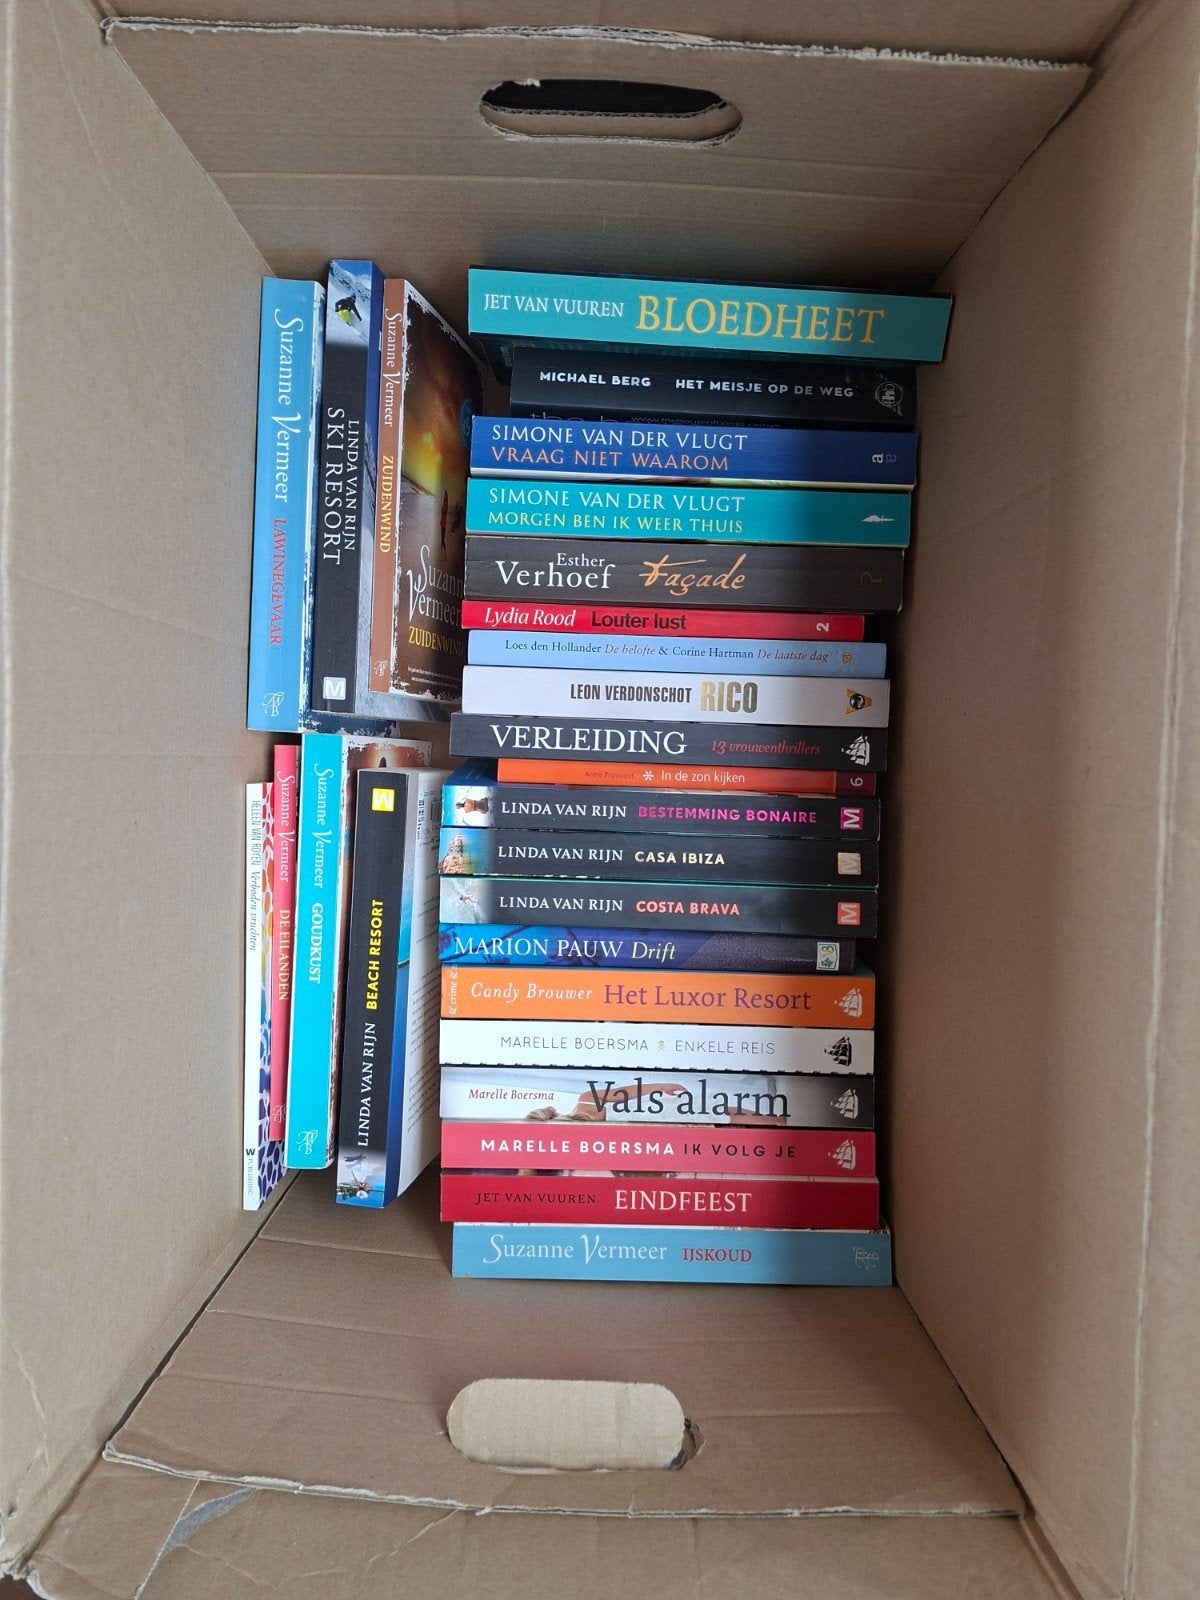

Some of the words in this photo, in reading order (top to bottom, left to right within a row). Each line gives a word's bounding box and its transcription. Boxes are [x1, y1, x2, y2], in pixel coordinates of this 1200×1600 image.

[483, 293, 511, 311] JET
[514, 296, 549, 312] VAN
[553, 298, 625, 318] VUUREN
[635, 295, 885, 344] BLOEDHEET
[385, 308, 402, 367] Suzanne
[274, 308, 304, 406] Suzanne
[539, 371, 606, 385] MICHAEL
[612, 375, 651, 387] BERG
[675, 378, 704, 390] HET
[709, 381, 763, 393] MEISJE
[767, 383, 788, 394] OP
[794, 385, 813, 395] DE
[820, 386, 853, 397] WEG
[382, 371, 401, 427] Vermeer
[326, 407, 345, 450] SKI
[492, 425, 573, 444] SIMONE
[582, 428, 624, 445] VAN
[630, 431, 669, 448] DER
[676, 433, 748, 450] VLUGT
[271, 412, 302, 503] Vermeer
[346, 420, 360, 476] LINDA
[491, 446, 565, 464] VRAAG
[574, 450, 622, 466] NIET
[631, 453, 729, 471] WAAROM
[345, 478, 358, 510] VAN
[380, 456, 394, 553] ZUIDENWIND
[489, 488, 569, 507] SIMONE
[579, 491, 620, 508] VAN
[627, 493, 665, 510] DER
[673, 494, 745, 512] VLUGT
[323, 462, 343, 565] RESORT
[488, 511, 565, 527] MORGEN
[573, 514, 605, 528] BEN
[613, 516, 630, 529] IK
[637, 516, 682, 531] WEER
[689, 518, 743, 533] THUIS
[342, 514, 356, 550] RIJN
[420, 544, 463, 599] Suzann
[556, 552, 606, 567] Esther
[269, 518, 287, 647] LAWINEGEVAAR
[495, 560, 616, 589] Verhoef
[638, 553, 747, 596] Façade
[406, 569, 461, 628] Vermeer
[484, 607, 529, 627] Lydia
[532, 609, 577, 626] Rood
[591, 611, 650, 629] Louter
[654, 613, 686, 630] lust
[816, 622, 829, 632] 2
[505, 640, 528, 651] Loes
[530, 640, 549, 651] den
[552, 641, 601, 653] Hollander
[604, 643, 620, 654] De
[622, 644, 656, 657] belofte
[658, 646, 669, 656] &
[672, 646, 705, 657] Corine
[709, 647, 754, 659] Hartman
[757, 650, 772, 659] De
[774, 650, 808, 660] laatste
[810, 651, 829, 663] dag
[325, 680, 344, 697] M
[570, 683, 601, 700] LEON
[605, 685, 692, 703] VERDONSCHOT
[701, 681, 759, 713] RICO
[489, 724, 687, 755] VERLEIDING
[711, 740, 726, 755] 13
[729, 740, 821, 756] vrouwenthrillers
[585, 771, 602, 779] Anne
[604, 771, 635, 780] Provoost
[661, 770, 671, 781] In
[675, 771, 688, 782] de
[691, 773, 711, 782] zon
[714, 772, 745, 786] kijken
[277, 770, 295, 826] Suzanne
[314, 763, 334, 826] Suzanne
[251, 800, 262, 826] HELEEN
[501, 801, 552, 815] LINDA
[555, 803, 587, 817] VAN
[592, 805, 627, 819] RIJN
[638, 806, 741, 821] BESTEMMING
[746, 809, 817, 824] BONAIRE
[252, 827, 262, 841] VAN
[251, 843, 262, 866] ROYEN
[277, 829, 296, 883] Vermeer
[312, 829, 333, 889] Vermeer
[498, 846, 549, 859] LINDA
[552, 847, 583, 860] VAN
[588, 849, 624, 863] RIJN
[634, 851, 677, 864] CASA
[682, 852, 725, 865] IBIZA
[250, 871, 261, 911] Verboden
[500, 896, 549, 909] LINDA
[552, 897, 584, 910] VAN
[589, 899, 624, 912] RIJN
[635, 900, 684, 914] COSTA
[690, 902, 740, 915] BRAVA
[279, 909, 290, 927] DE
[369, 900, 384, 955] RESORT
[309, 902, 324, 984] GOUDKUST
[454, 938, 549, 956] MARION
[557, 939, 623, 958] PAUW
[631, 940, 676, 963] Drift
[278, 931, 290, 1001] EILANDEN
[366, 959, 381, 1010] BEACH
[471, 982, 520, 1004] Candy
[526, 983, 593, 1000] Brouwer
[604, 984, 648, 1005] Het
[654, 986, 726, 1006] Luxor
[734, 988, 811, 1010] Resort
[363, 1022, 376, 1058] RIJN
[500, 1036, 568, 1049] MARELLE
[574, 1038, 649, 1051] BOERSMA
[675, 1039, 735, 1054] ENKELE
[741, 1042, 776, 1055] REIS
[361, 1062, 374, 1094] VAN
[468, 1088, 508, 1100] Marelle
[510, 1089, 554, 1101] Boersma
[586, 1077, 664, 1114] Vals
[676, 1079, 791, 1118] alarm
[358, 1096, 371, 1147] LINDA
[481, 1139, 570, 1153] MARELLE
[580, 1140, 674, 1155] BOERSMA
[684, 1143, 702, 1155] IK
[711, 1144, 766, 1157] VOLG
[774, 1146, 795, 1158] JE
[475, 1192, 500, 1206] JET
[505, 1193, 533, 1203] VAN
[538, 1193, 596, 1204] VUUREN
[614, 1189, 752, 1213] EINDFEEST
[483, 1234, 574, 1264] Suzanne
[579, 1234, 668, 1265] Vermeer
[682, 1247, 752, 1263] IJSKOUD
